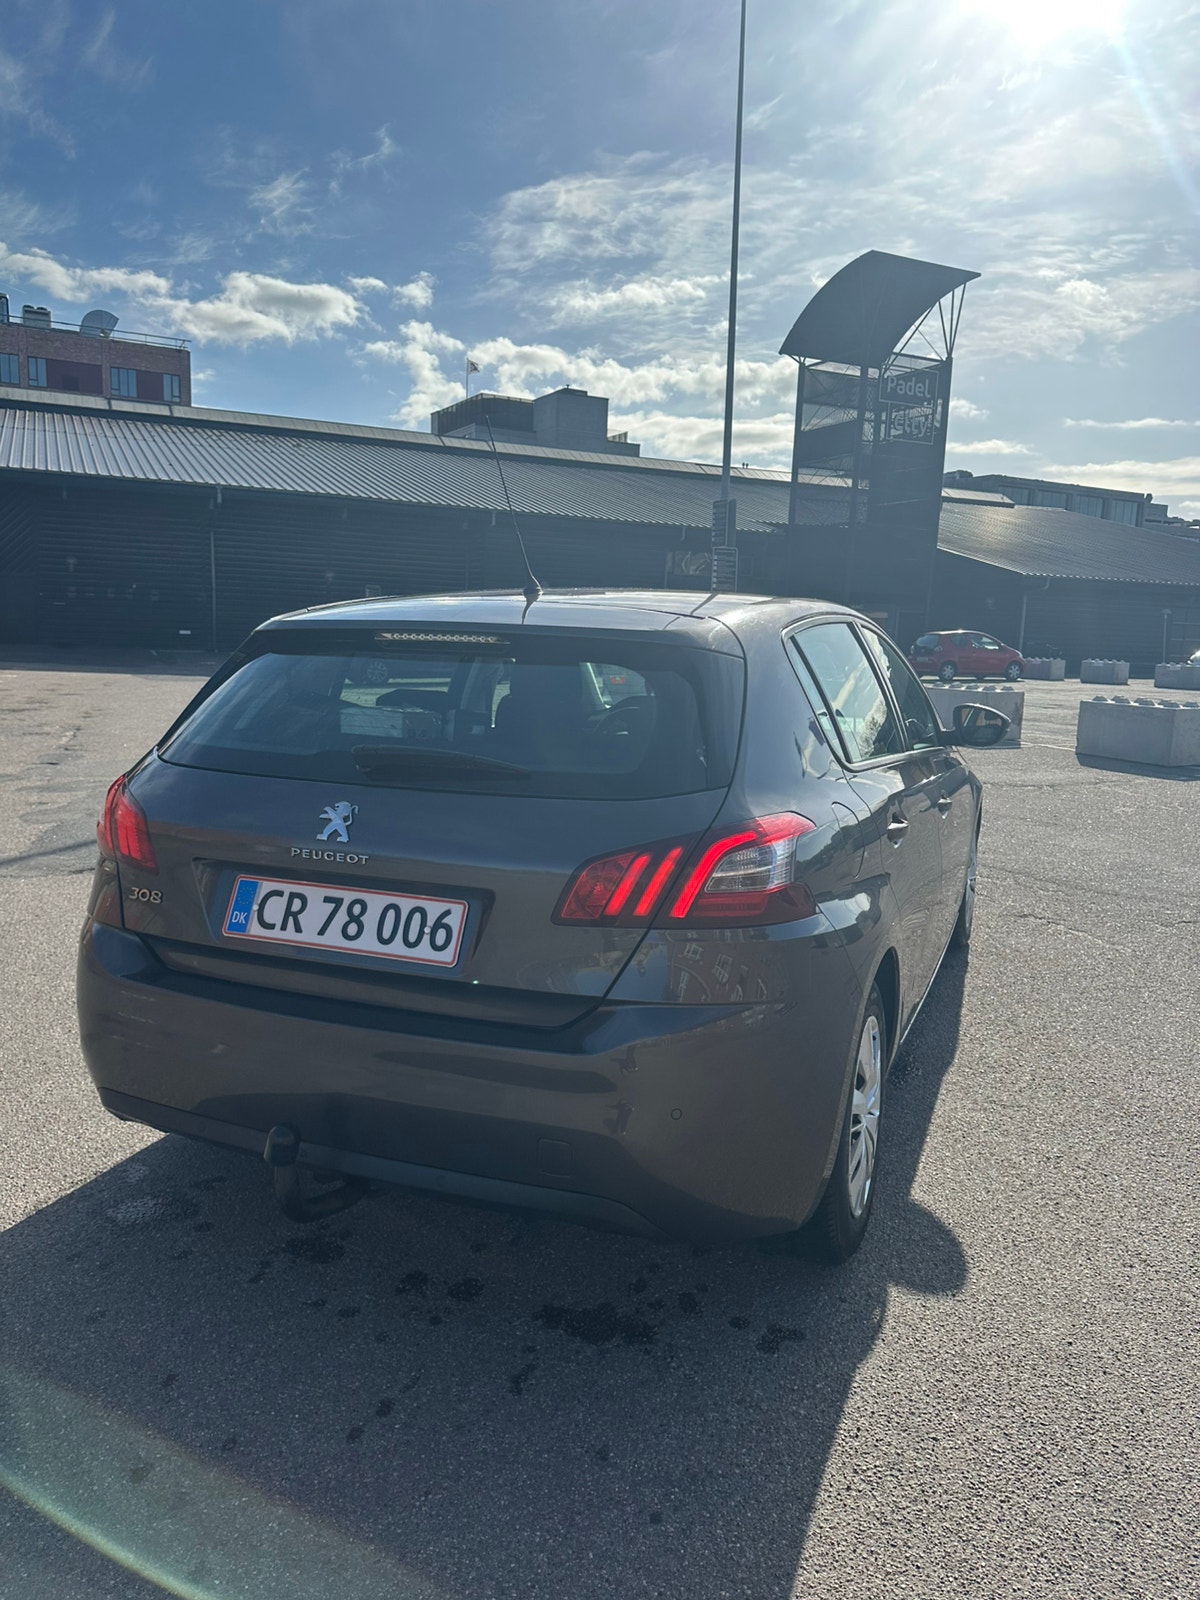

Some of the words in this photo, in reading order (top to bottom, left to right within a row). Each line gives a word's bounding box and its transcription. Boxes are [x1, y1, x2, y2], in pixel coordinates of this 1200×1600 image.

[887, 376, 931, 398] Padel
[290, 847, 369, 865] PEUGEOT
[129, 887, 163, 904] 308
[232, 911, 248, 924] DK
[256, 889, 308, 934] CR
[316, 895, 368, 941] 78
[376, 903, 453, 952] 006
